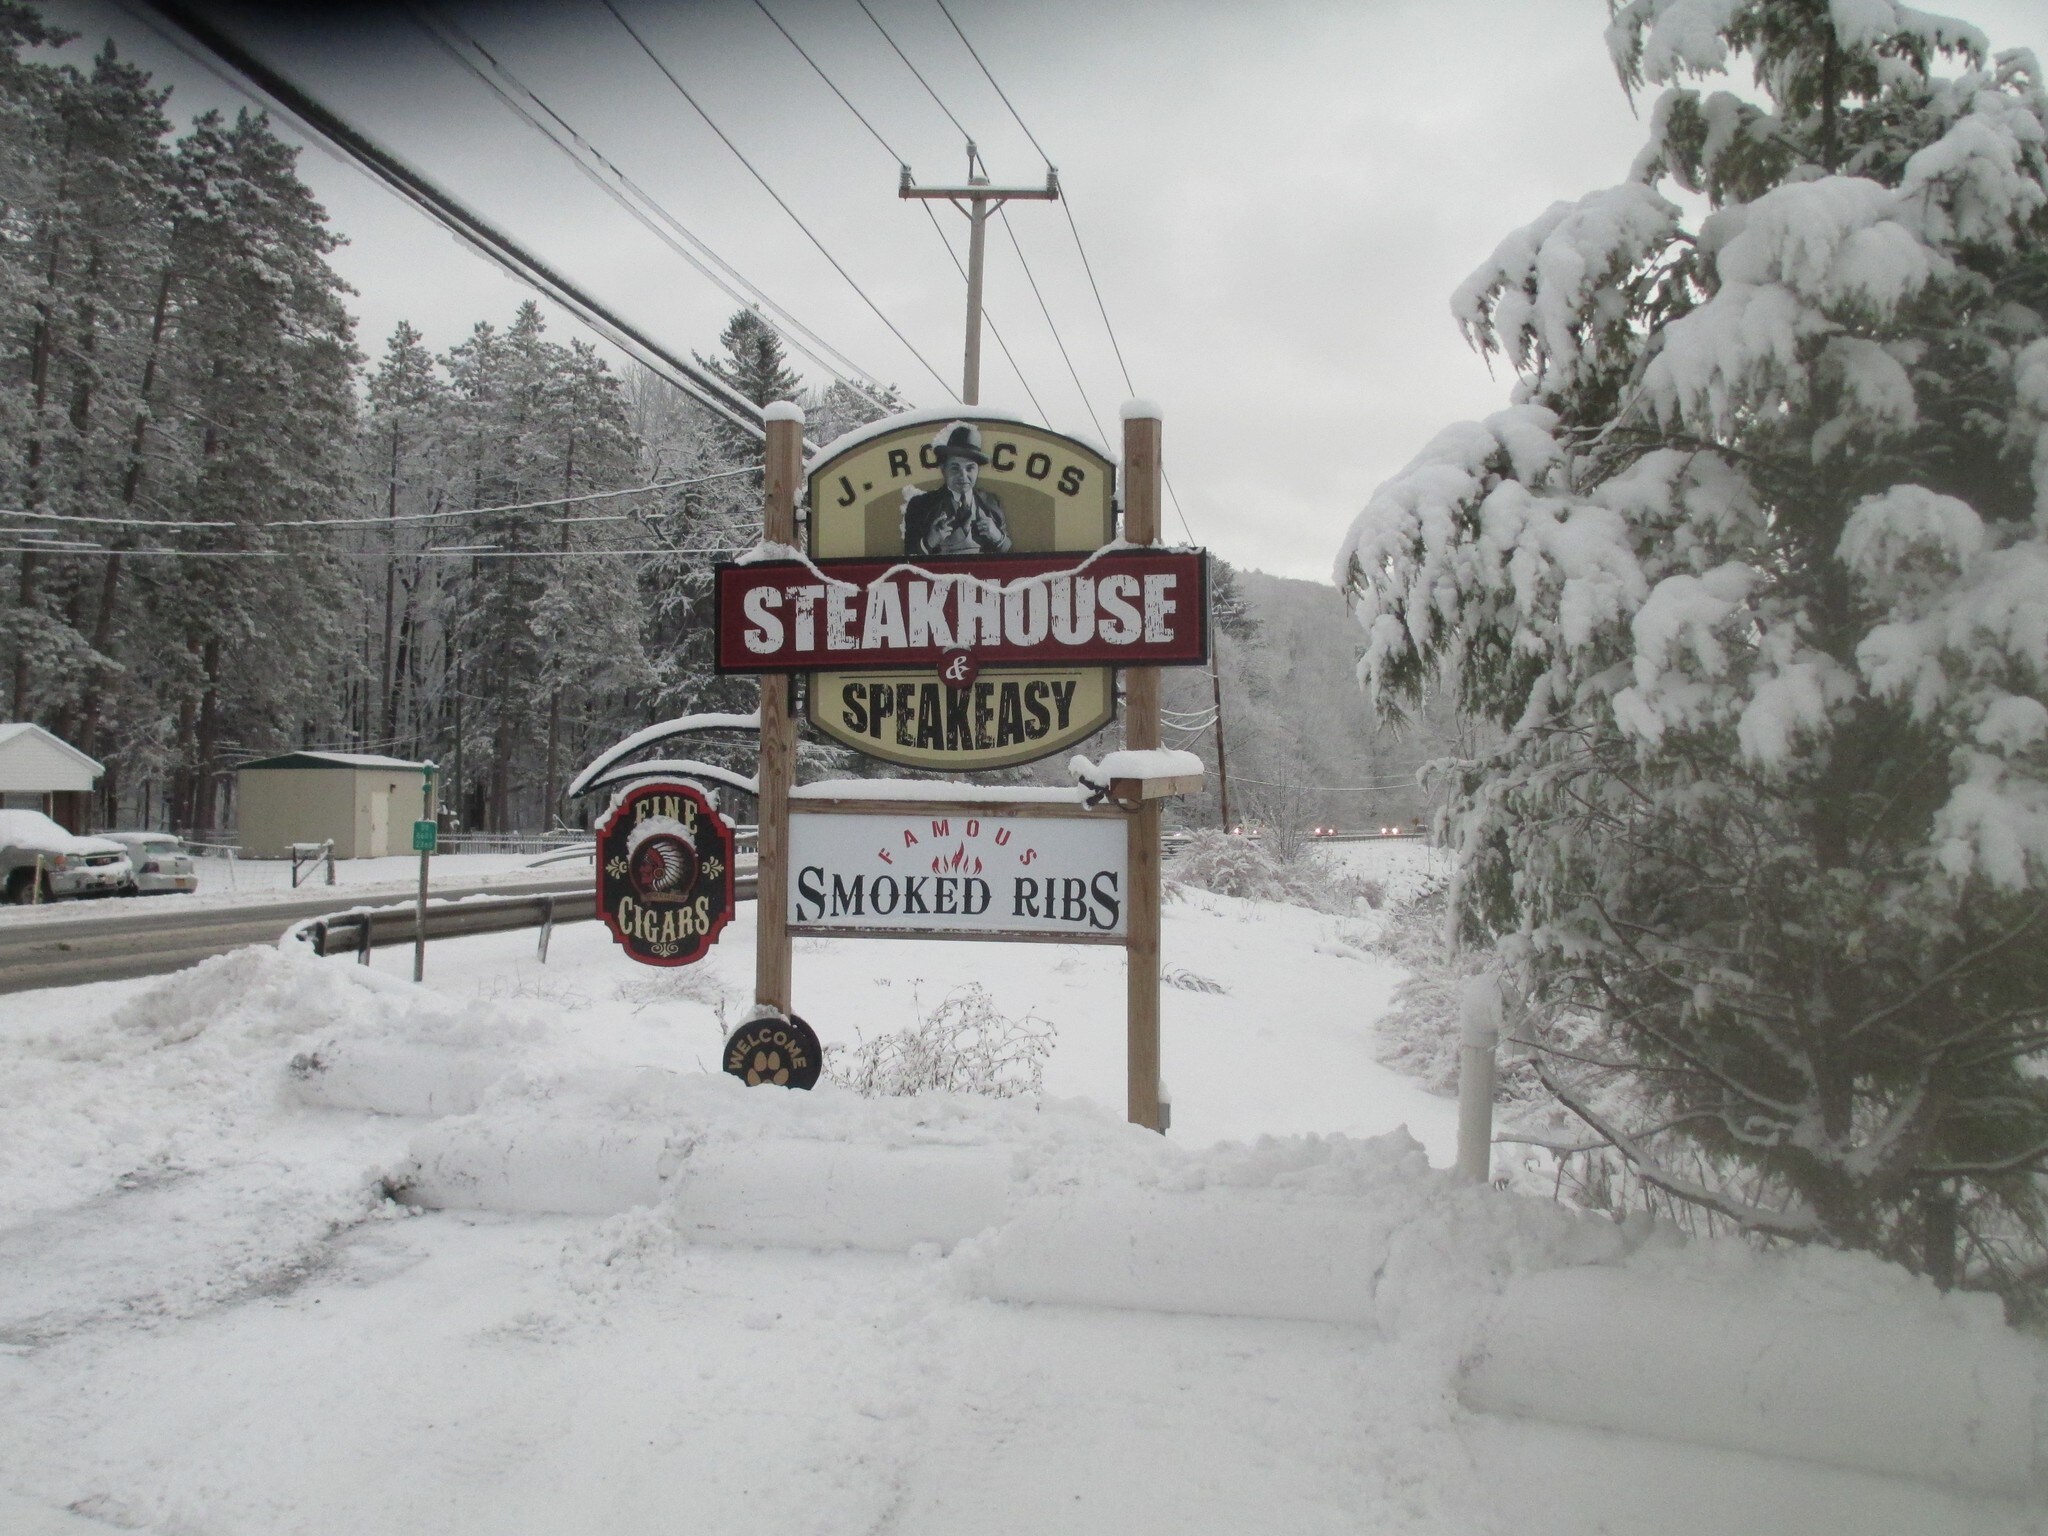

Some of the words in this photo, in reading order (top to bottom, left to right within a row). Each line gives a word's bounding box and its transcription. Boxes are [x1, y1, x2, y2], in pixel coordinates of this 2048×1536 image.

[836, 475, 874, 508] J.
[742, 574, 1177, 654] STEAKHOUSE
[945, 656, 971, 681] &
[842, 680, 1077, 751] SPEAKEASY
[634, 795, 698, 835] FINE
[878, 819, 1038, 866] FAMOUS
[617, 895, 710, 943] CIGARS
[796, 866, 993, 923] SMOKED
[1012, 871, 1121, 930] RIBS
[728, 1028, 807, 1070] WELCOME
